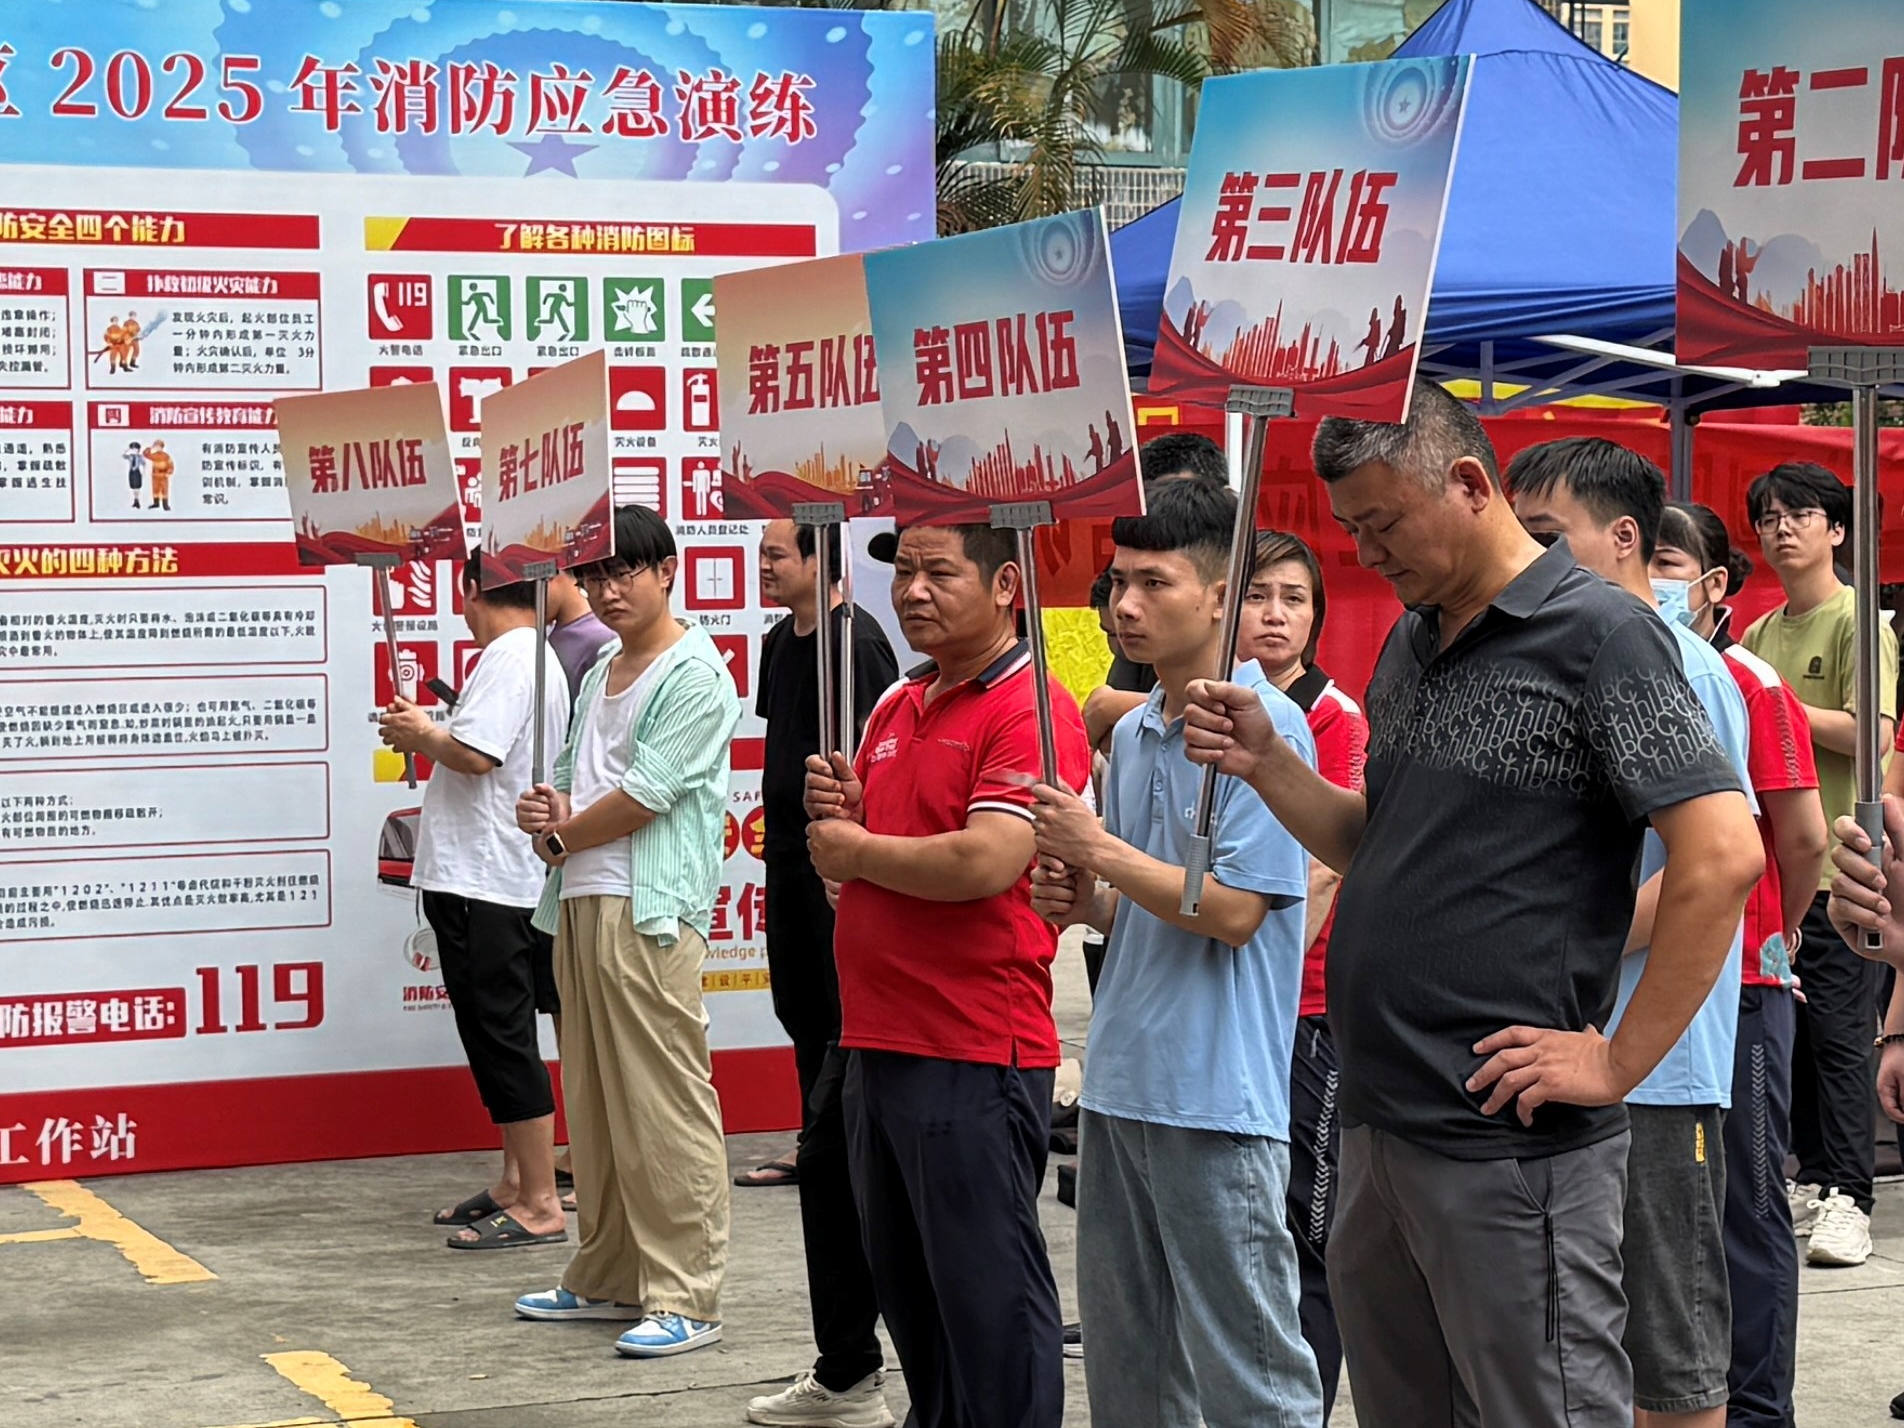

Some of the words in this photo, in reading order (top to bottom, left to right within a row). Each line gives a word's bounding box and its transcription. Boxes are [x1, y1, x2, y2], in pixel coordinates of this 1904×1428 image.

[52, 48, 263, 128] 2025
[288, 54, 819, 145] 年消防应急演练
[493, 222, 696, 253] 了解各种消防图标
[1204, 169, 1398, 266] 第三队伍
[398, 281, 427, 306] 119
[747, 330, 881, 416] 第五队伍
[912, 307, 1081, 408] 第四队伍
[308, 437, 428, 494] 第八队伍
[498, 421, 585, 505] 第七队伍
[194, 960, 325, 1034] 119
